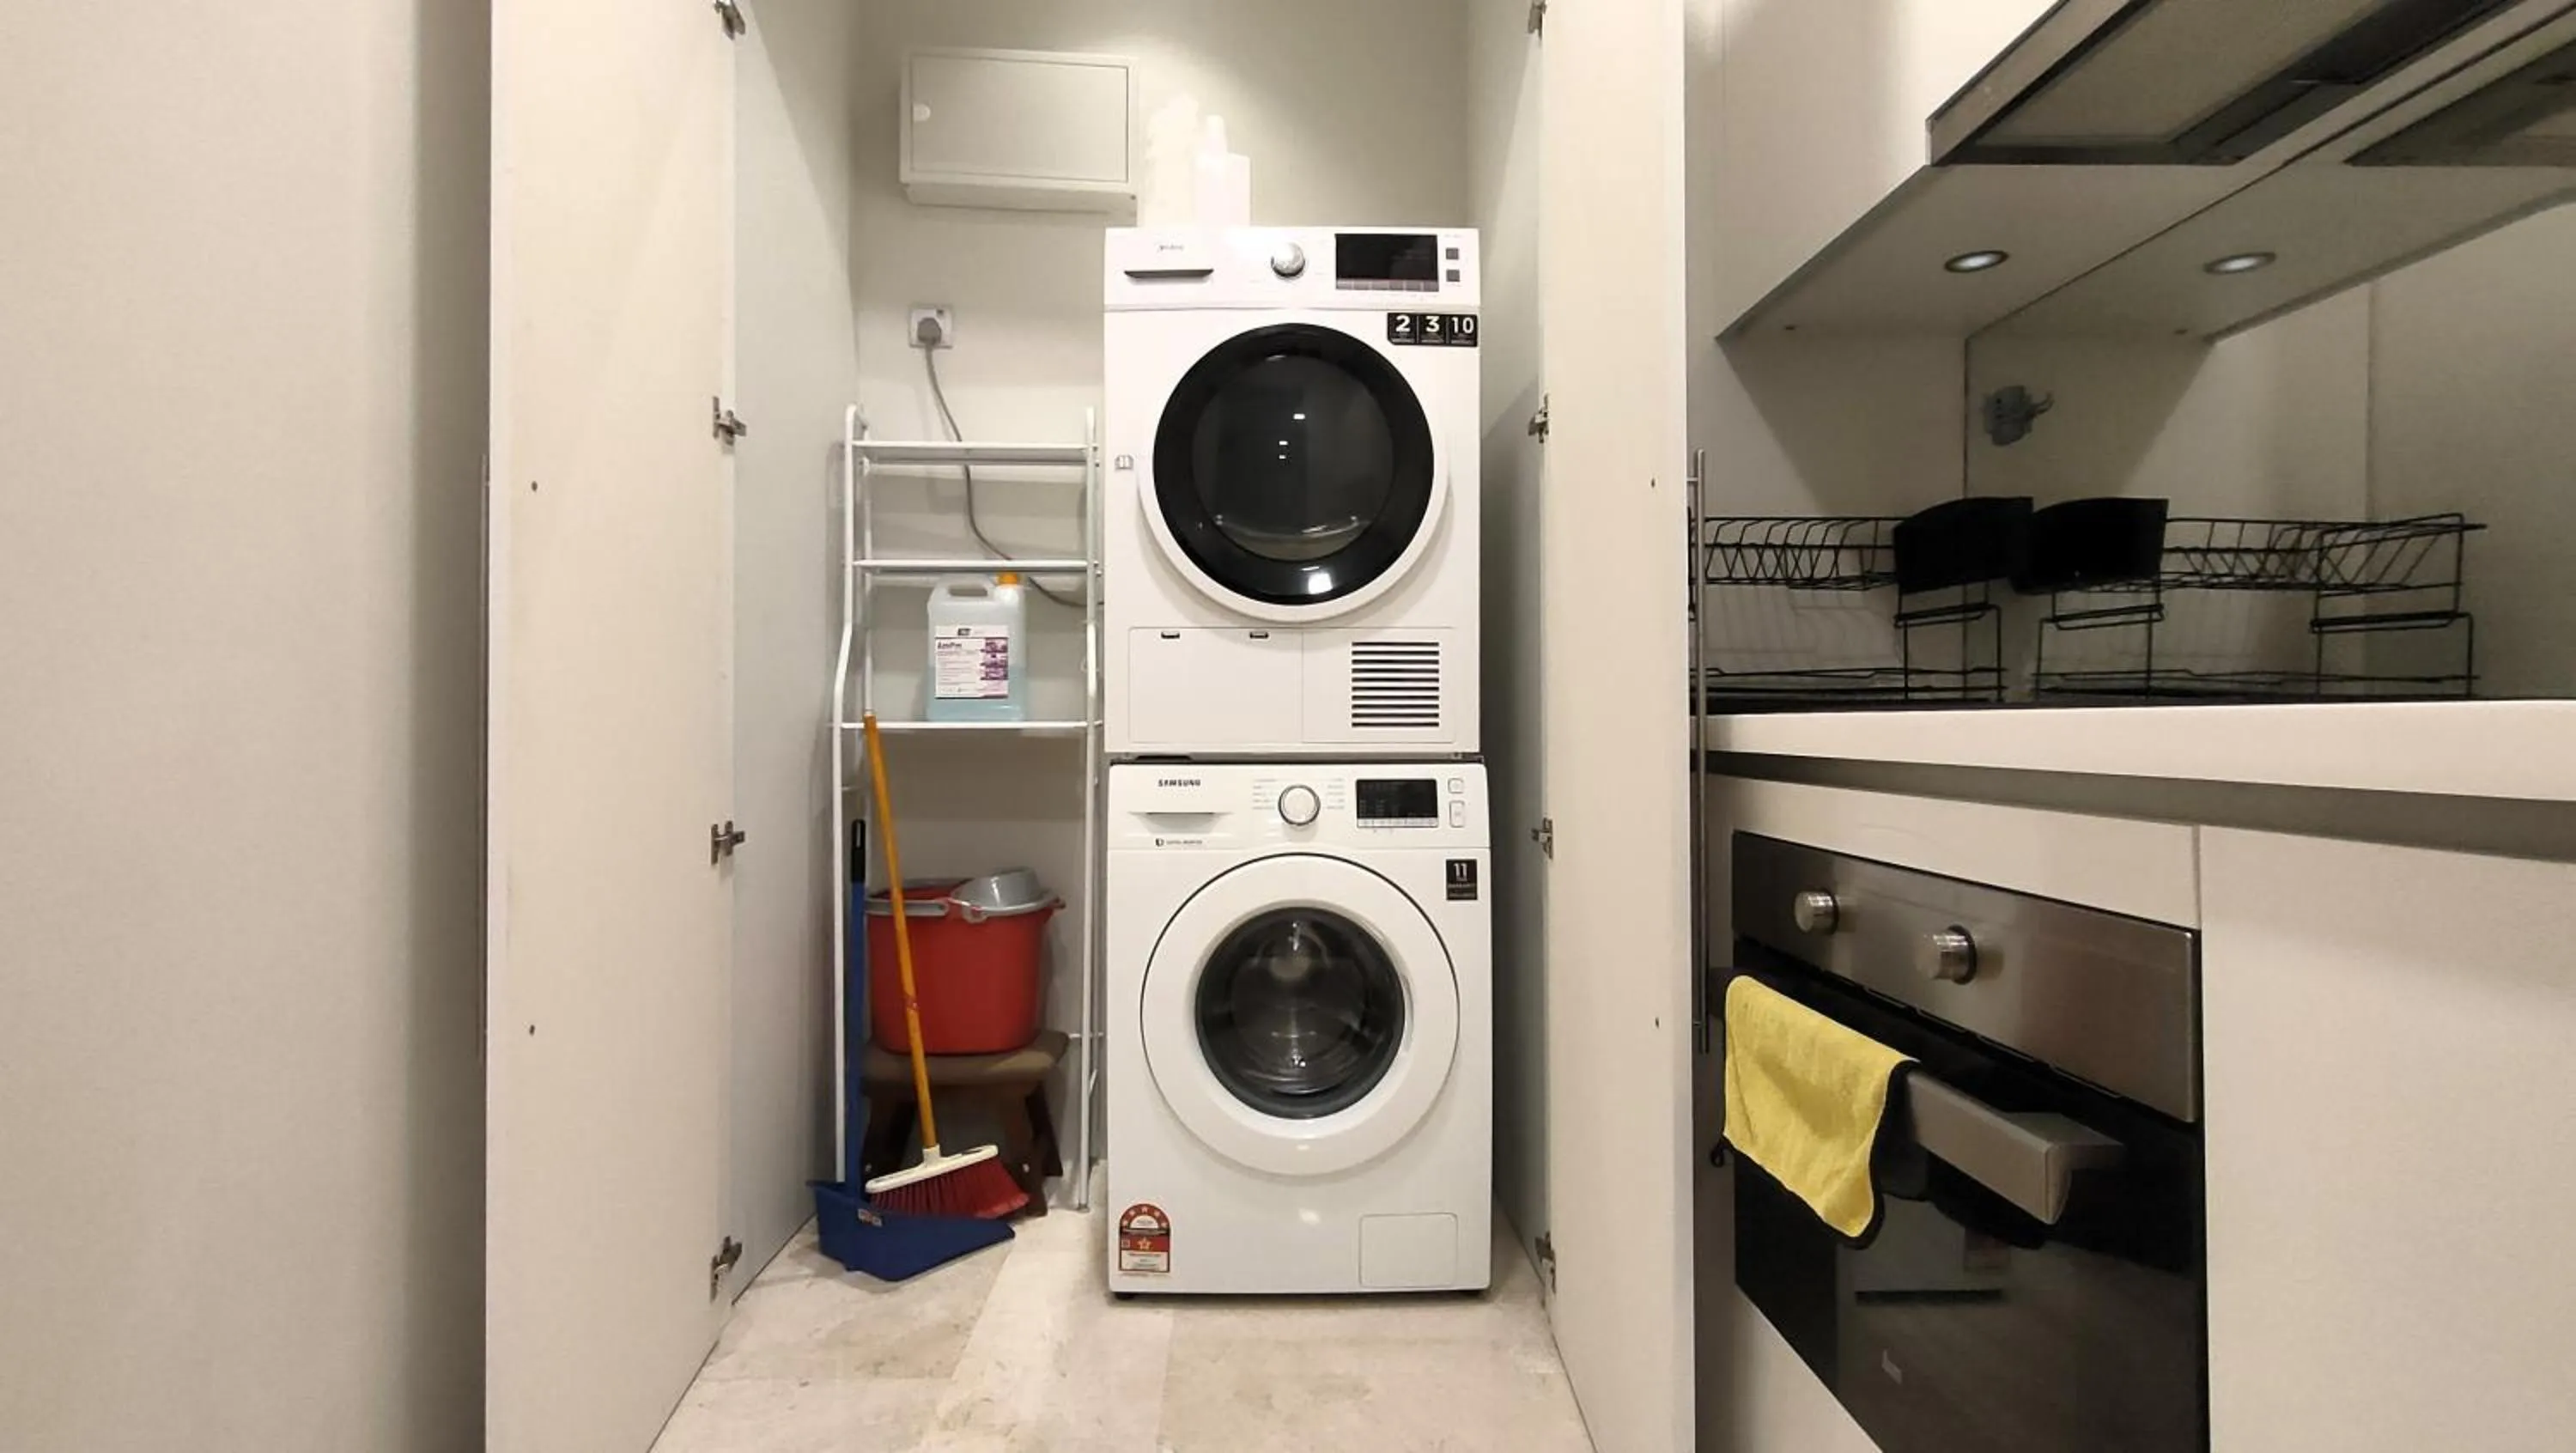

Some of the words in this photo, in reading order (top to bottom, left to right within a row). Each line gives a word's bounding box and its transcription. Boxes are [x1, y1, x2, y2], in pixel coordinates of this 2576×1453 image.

[1395, 314, 1411, 332] 2
[1425, 315, 1440, 332] 3
[1452, 317, 1474, 334] 10
[1157, 779, 1201, 787] SAMSUNG
[1453, 862, 1467, 877] 11
